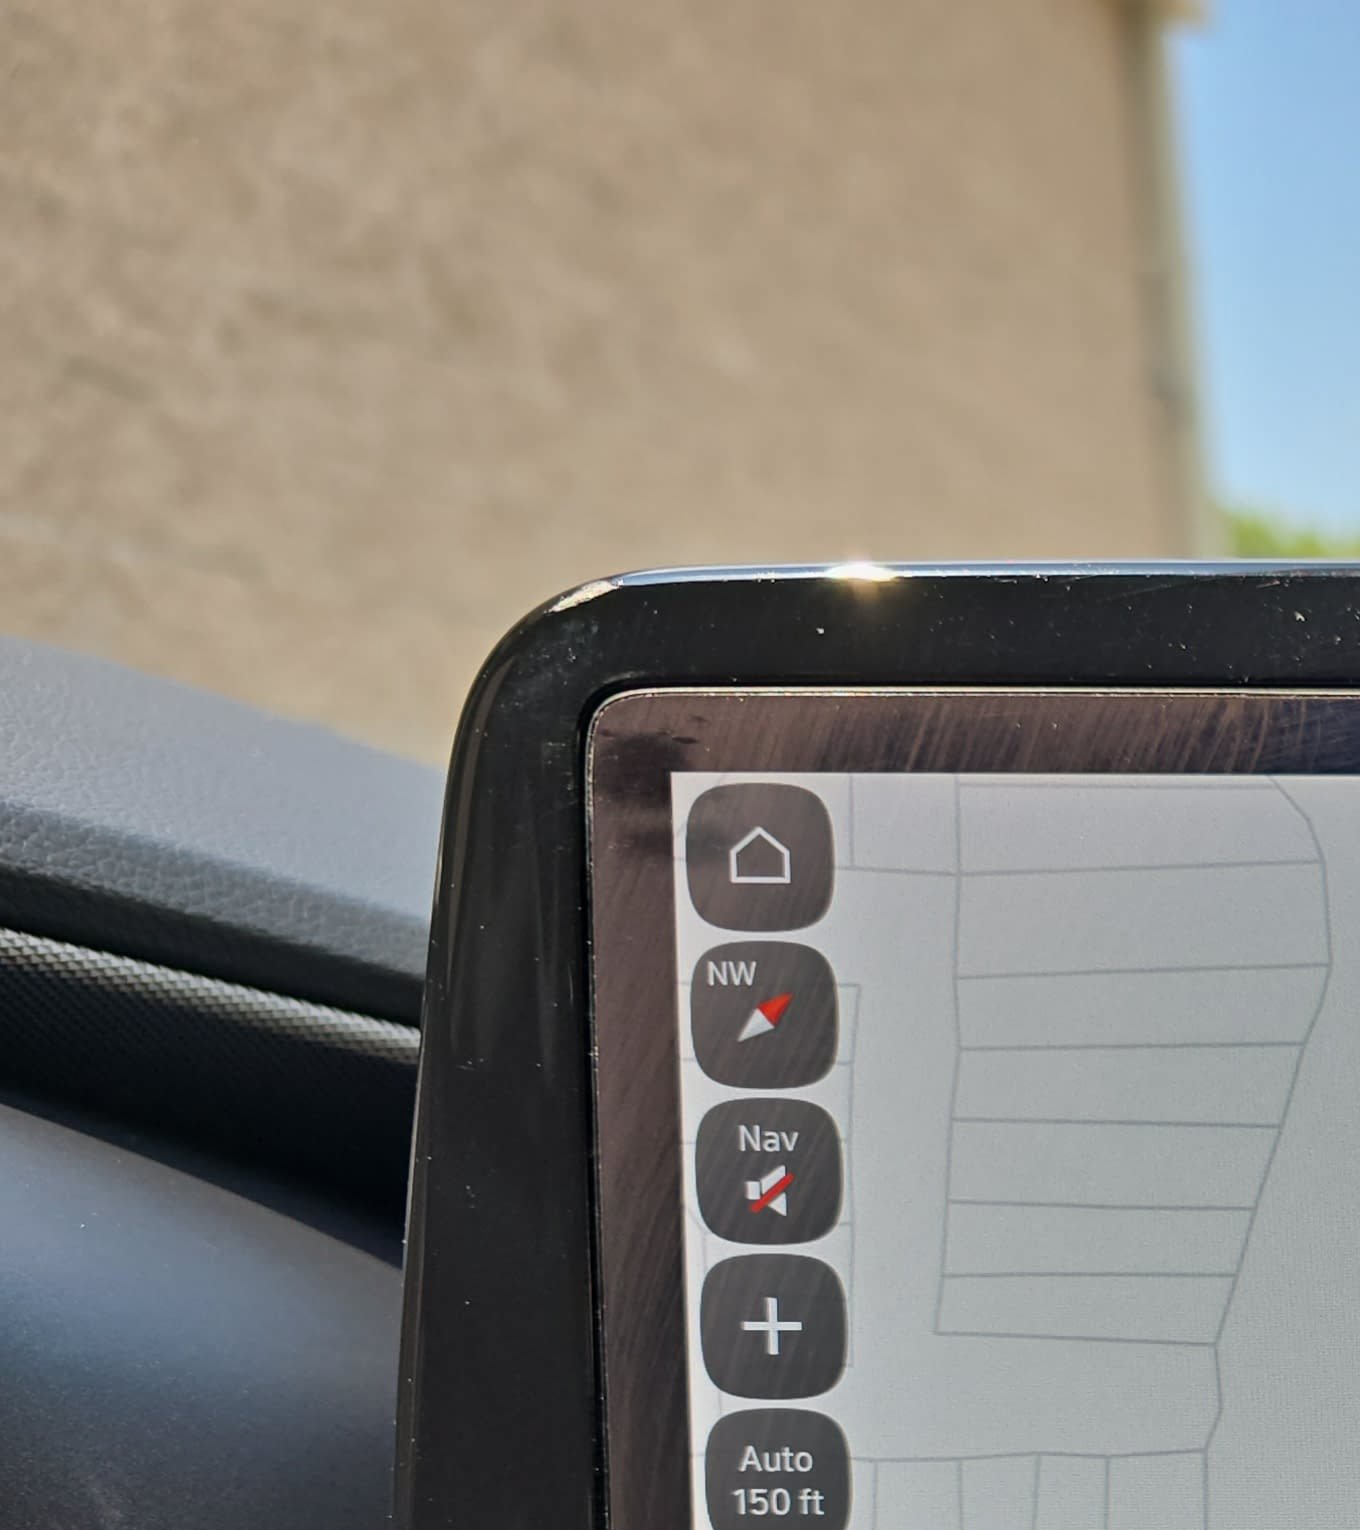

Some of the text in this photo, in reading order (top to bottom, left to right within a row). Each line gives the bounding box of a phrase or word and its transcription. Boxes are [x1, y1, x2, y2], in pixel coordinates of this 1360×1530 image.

[706, 961, 757, 986] NW
[738, 1125, 799, 1152] Nav
[737, 1445, 814, 1473] Auto
[731, 1488, 825, 1516] 150 ft
